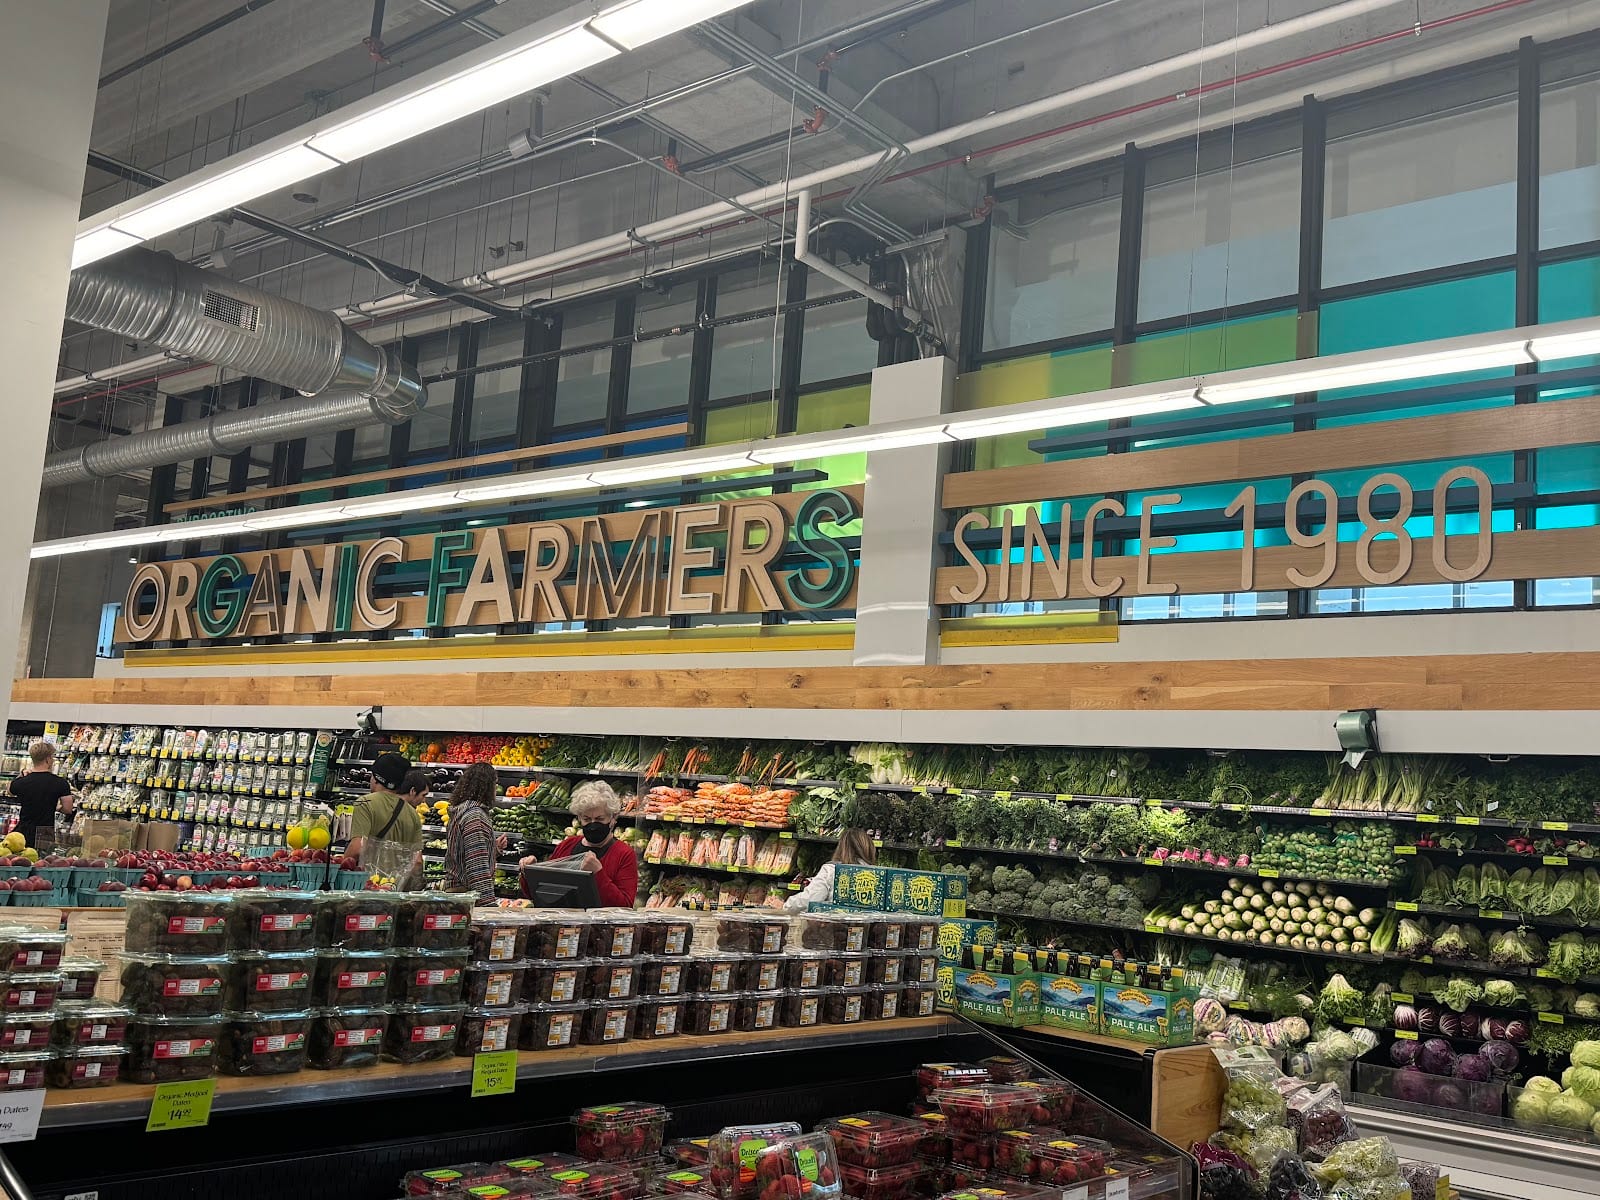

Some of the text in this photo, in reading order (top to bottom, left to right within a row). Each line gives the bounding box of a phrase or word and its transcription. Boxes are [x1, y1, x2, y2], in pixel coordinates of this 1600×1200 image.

[948, 465, 1493, 604] SINCE 1980
[125, 489, 859, 641] ORGANIC FARMERS
[857, 890, 872, 903] IPA
[912, 896, 929, 910] IPA
[963, 1001, 1002, 1014] PALE ALE
[1045, 1006, 1086, 1021] PALE ALE
[1111, 1017, 1156, 1033] PALE ALE
[4, 1106, 29, 1114] Dates
